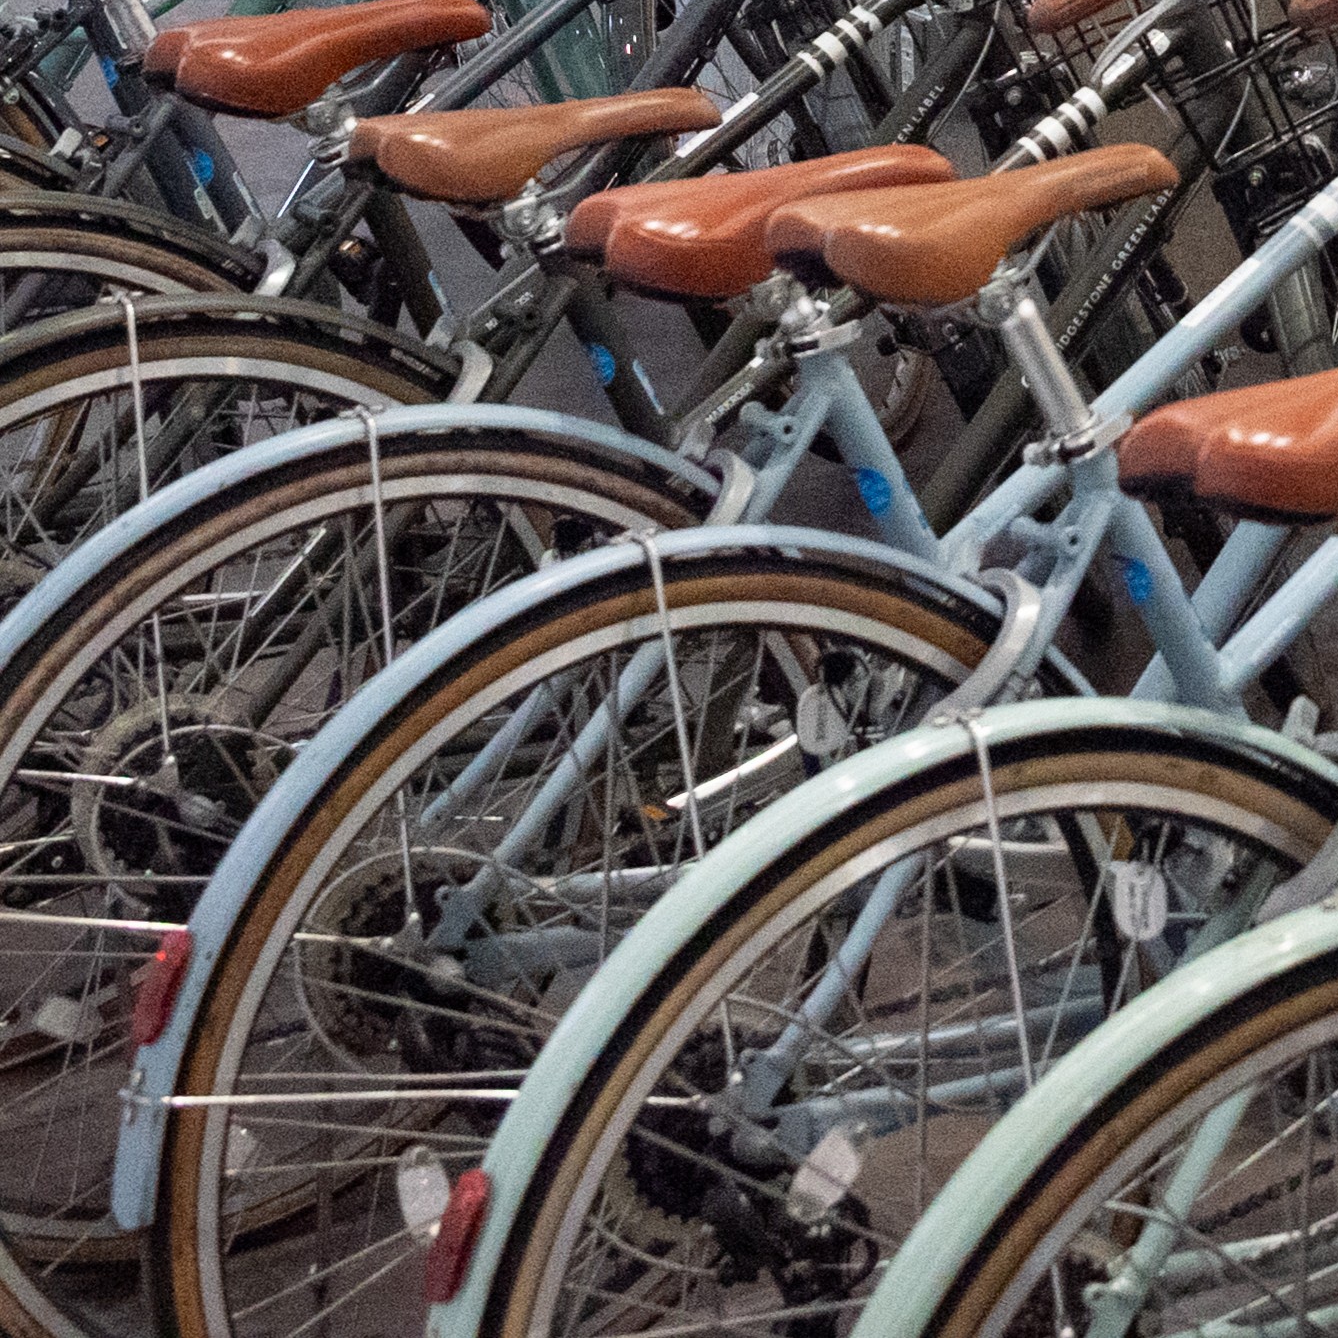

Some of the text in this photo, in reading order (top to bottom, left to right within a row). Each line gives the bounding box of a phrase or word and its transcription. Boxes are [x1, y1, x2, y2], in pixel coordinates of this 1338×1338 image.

[911, 85, 945, 124] LABEL
[1056, 273, 1114, 351] IDGESTONE
[1111, 222, 1148, 271] GREEN
